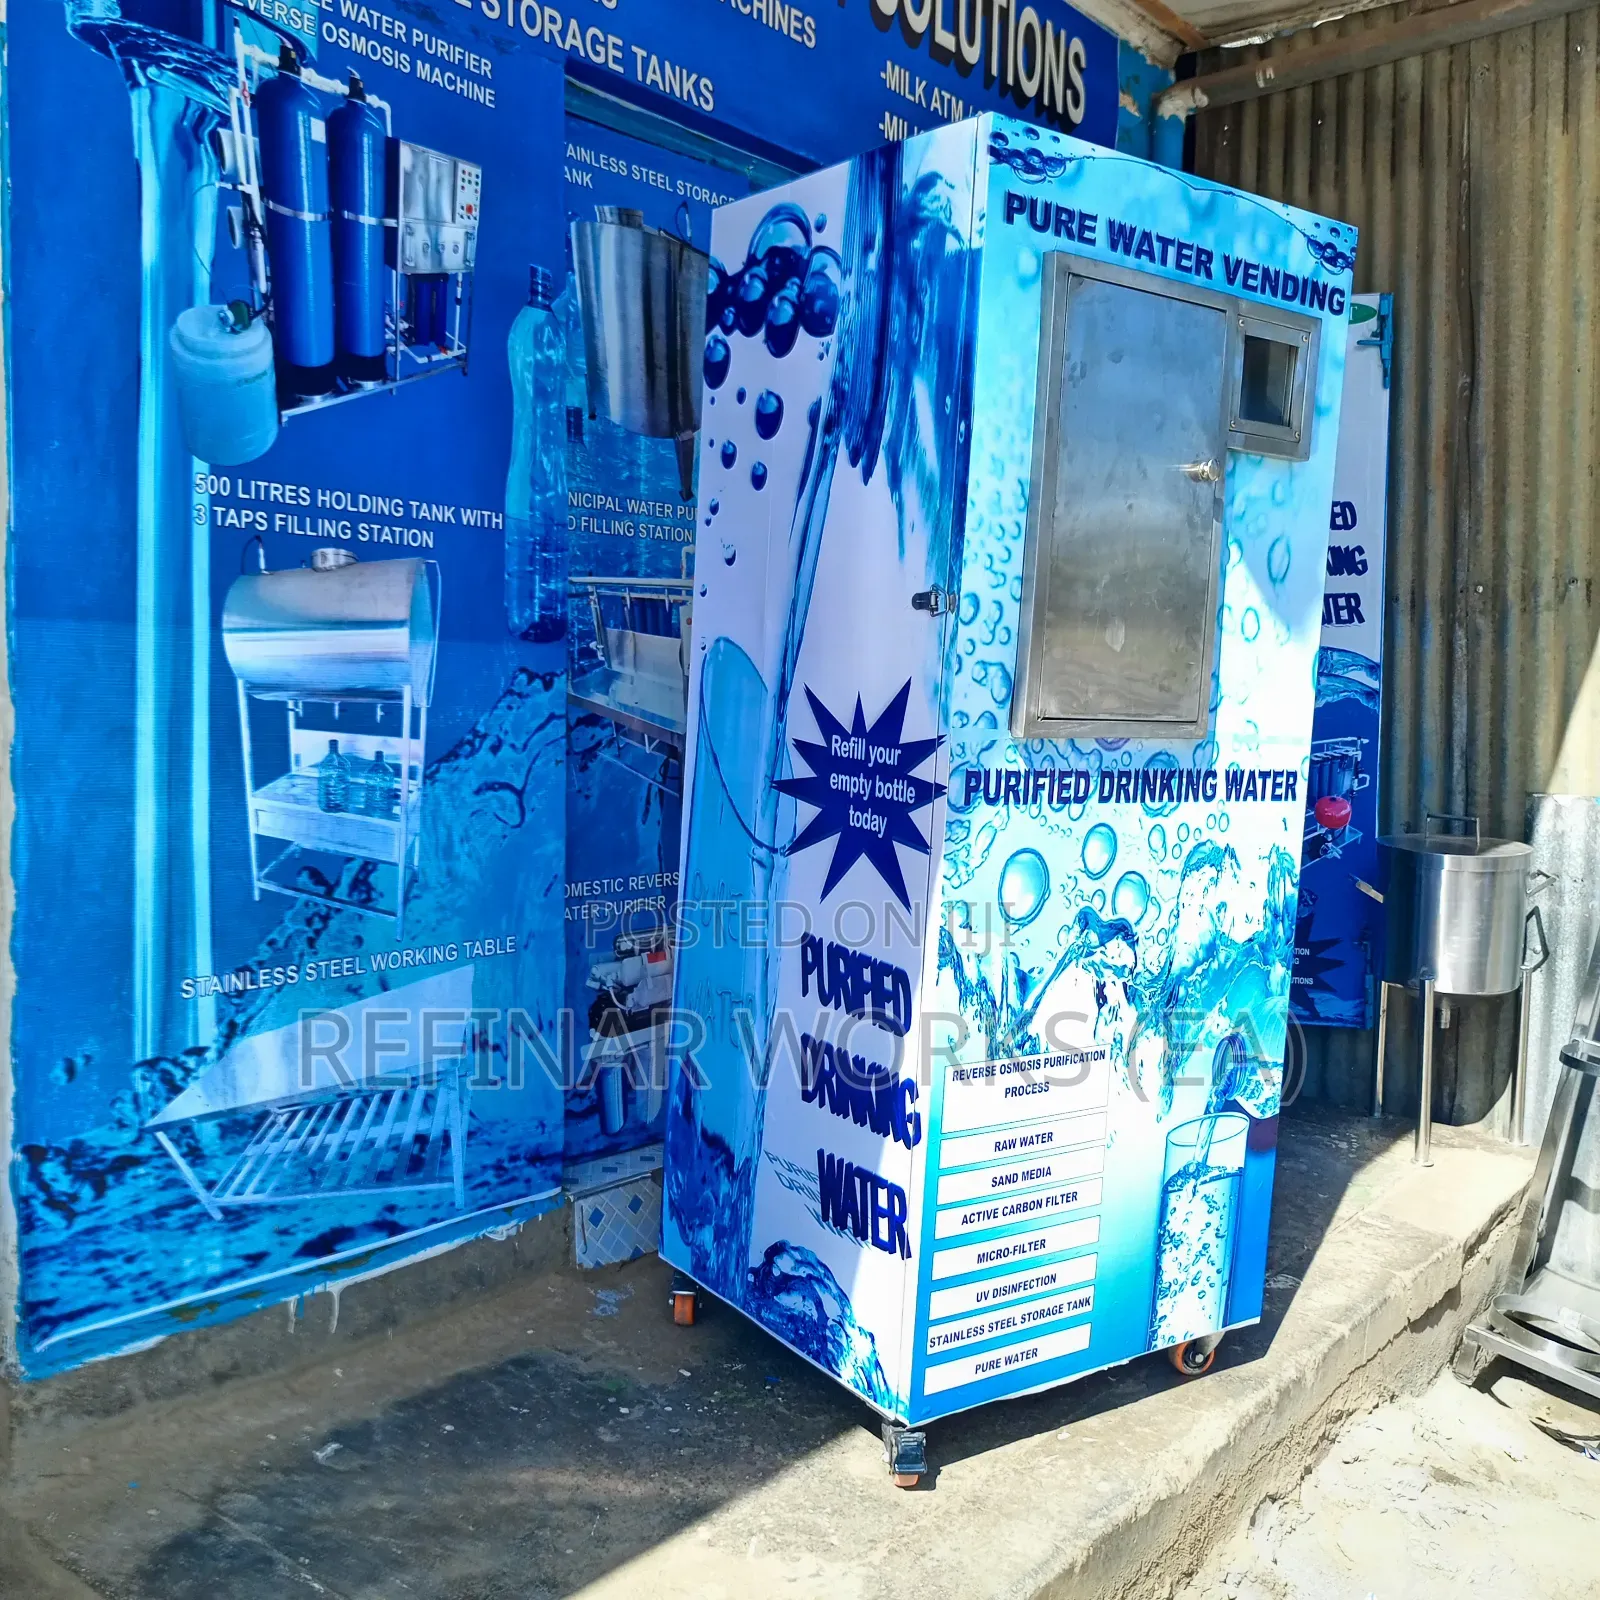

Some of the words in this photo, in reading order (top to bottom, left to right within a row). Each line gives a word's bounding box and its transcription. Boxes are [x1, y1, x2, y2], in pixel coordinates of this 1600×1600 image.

[340, 0, 406, 50] WATER
[412, 31, 493, 80] PURIFIER
[322, 21, 412, 74] OSMOSIS
[415, 60, 496, 109] MACHINE
[631, 45, 714, 112] TANKS
[880, 60, 928, 109] -MILK
[930, 86, 964, 122] ATM
[564, 142, 628, 176] AINLESS
[631, 164, 673, 192] STEEL
[676, 179, 735, 206] STORAG
[1003, 189, 1098, 247] PURE
[1107, 217, 1214, 279] WATER
[1222, 252, 1345, 316] VENDING
[194, 473, 231, 496] 500
[237, 478, 311, 506] LITRES
[317, 488, 403, 517] HOLDING
[409, 501, 456, 524] TANK
[461, 508, 503, 530] WITH
[568, 491, 623, 513] NICIPAL
[627, 498, 673, 518] WATER
[677, 505, 698, 521] PU
[194, 504, 207, 525] 3
[212, 506, 268, 531] TAPS
[275, 513, 351, 540] FILLING
[357, 523, 434, 549] STATION
[581, 516, 634, 537] FILLING
[639, 523, 693, 543] STATION
[831, 735, 866, 761] Refill
[868, 745, 901, 767] your
[829, 773, 872, 800] empty
[875, 775, 916, 804] bottle
[963, 767, 1090, 806] PURIFIED
[1098, 767, 1218, 804] DRINKING
[1225, 768, 1298, 802] WATER
[849, 805, 887, 838] today
[564, 903, 600, 921] ATER
[604, 896, 666, 917] PURIFIER
[180, 965, 299, 999] STAINLESS
[305, 956, 367, 982] STEEL
[370, 943, 458, 972] WORKING
[463, 936, 516, 959] TABLE
[952, 1065, 997, 1081] REVERSE
[999, 1058, 1041, 1075] OSMOSIS
[1043, 1049, 1106, 1068] PURIFICATION
[1004, 1081, 1050, 1098] PROCESS
[994, 1138, 1017, 1152] RAW
[1020, 1131, 1053, 1147] WATER
[991, 1173, 1018, 1188] SAND
[1021, 1166, 1052, 1182] MEDIA
[816, 1147, 913, 1261] WATER
[961, 1208, 999, 1225] ACTIVE
[1002, 1199, 1042, 1217] CARBON
[1045, 1191, 1078, 1207] FILTER
[977, 1238, 1046, 1264] MICRO-FILTER
[976, 1290, 990, 1303] UV
[992, 1273, 1057, 1299] DISINFECTION
[929, 1325, 985, 1348] STAINLESS
[988, 1316, 1018, 1333] STEEL
[1020, 1303, 1064, 1324] STORAGE
[1067, 1296, 1091, 1312] TANK
[975, 1358, 1001, 1375] PURE
[1004, 1348, 1038, 1366] WATER
